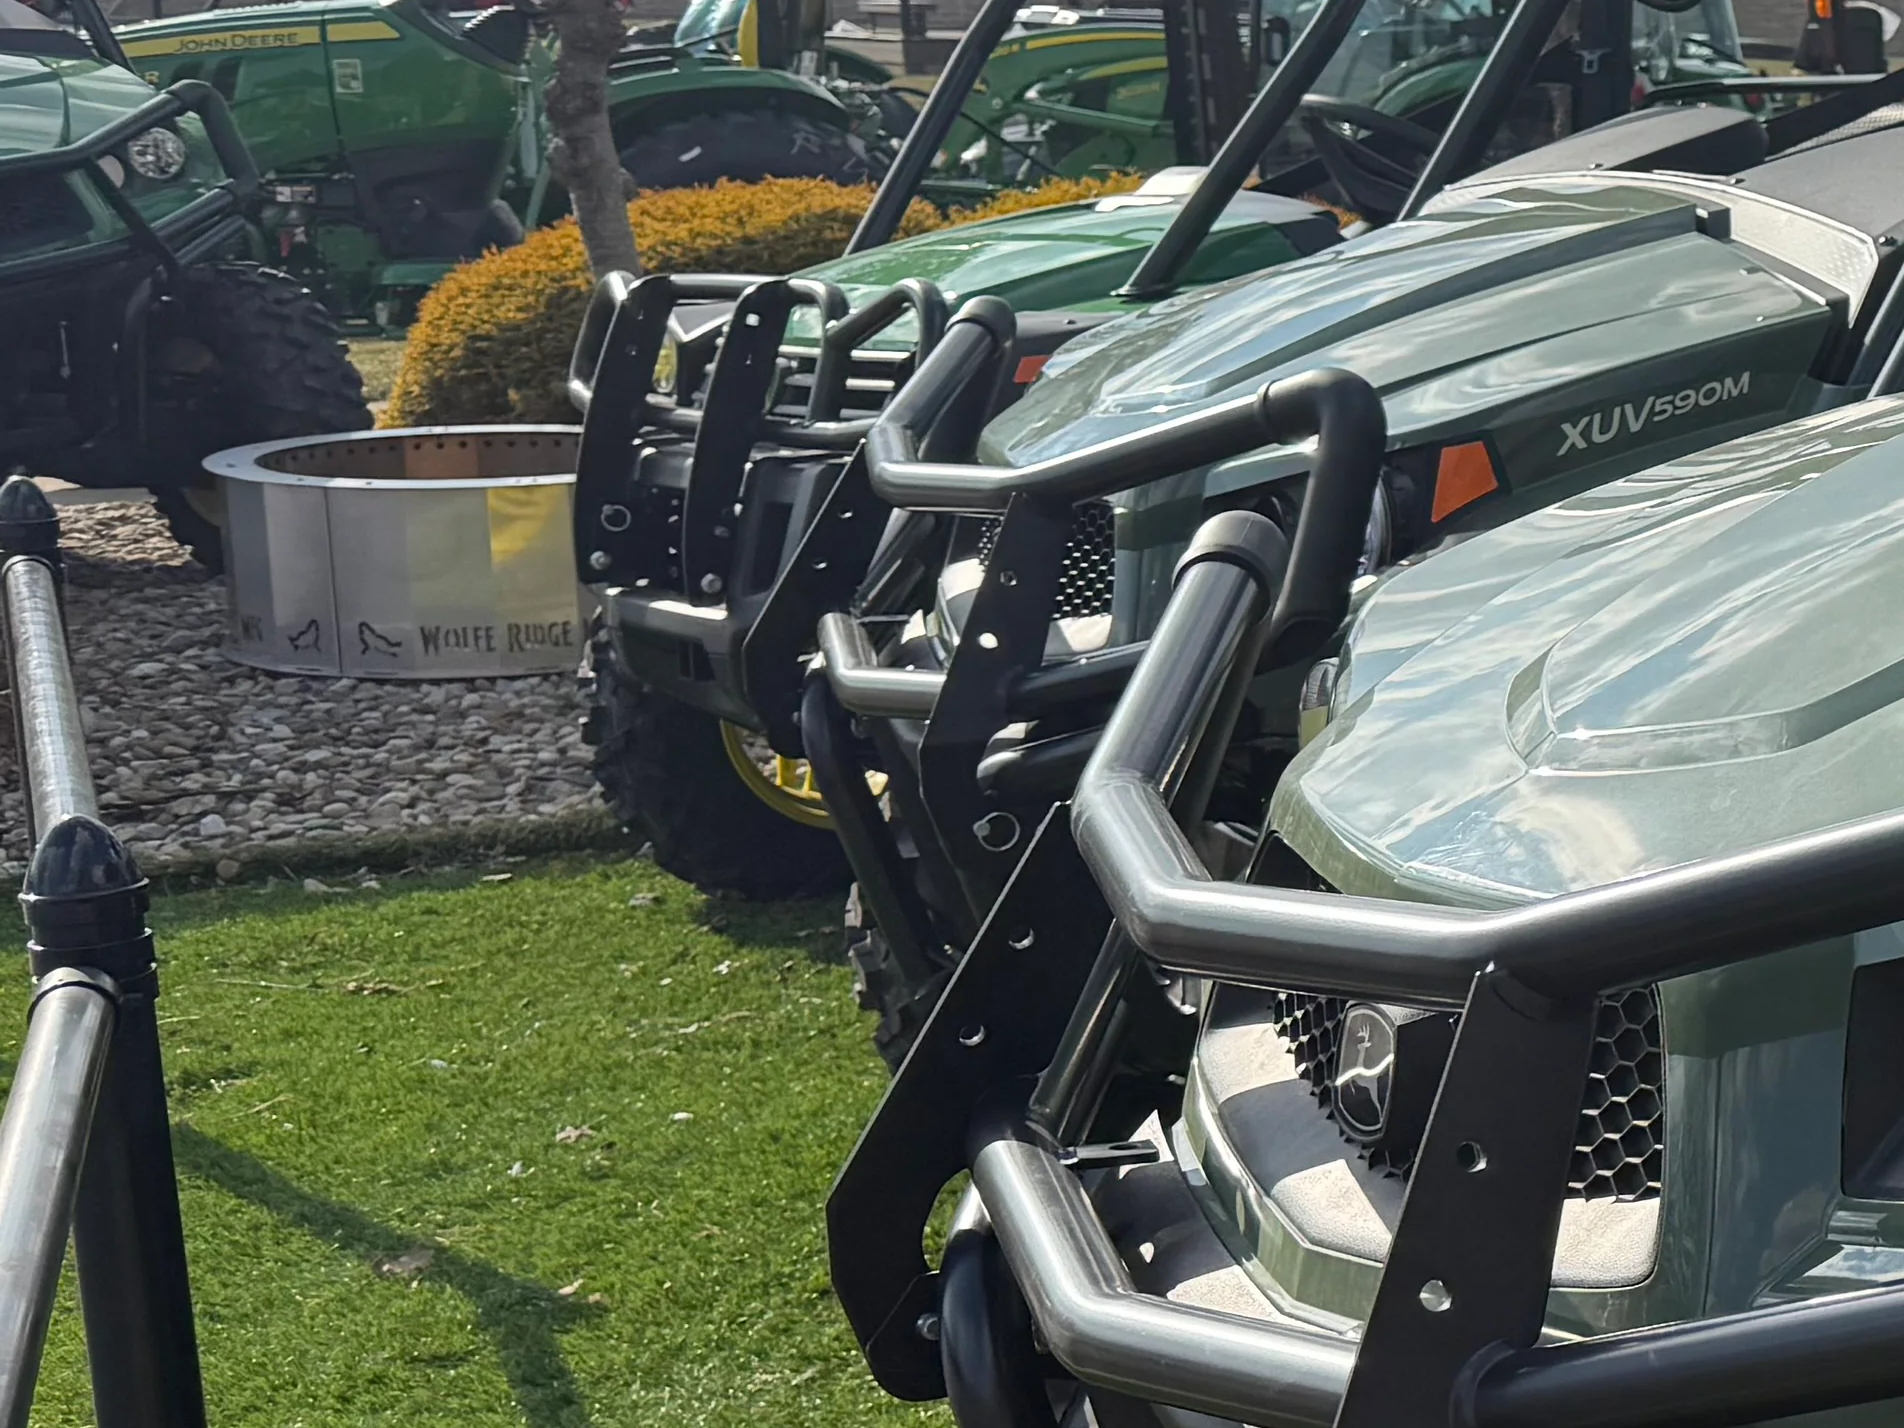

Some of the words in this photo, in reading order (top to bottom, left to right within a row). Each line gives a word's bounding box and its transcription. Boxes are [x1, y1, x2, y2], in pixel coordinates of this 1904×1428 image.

[174, 38, 227, 53] JOHN
[231, 32, 298, 47] DEERE
[1556, 371, 1751, 457] XUV590M
